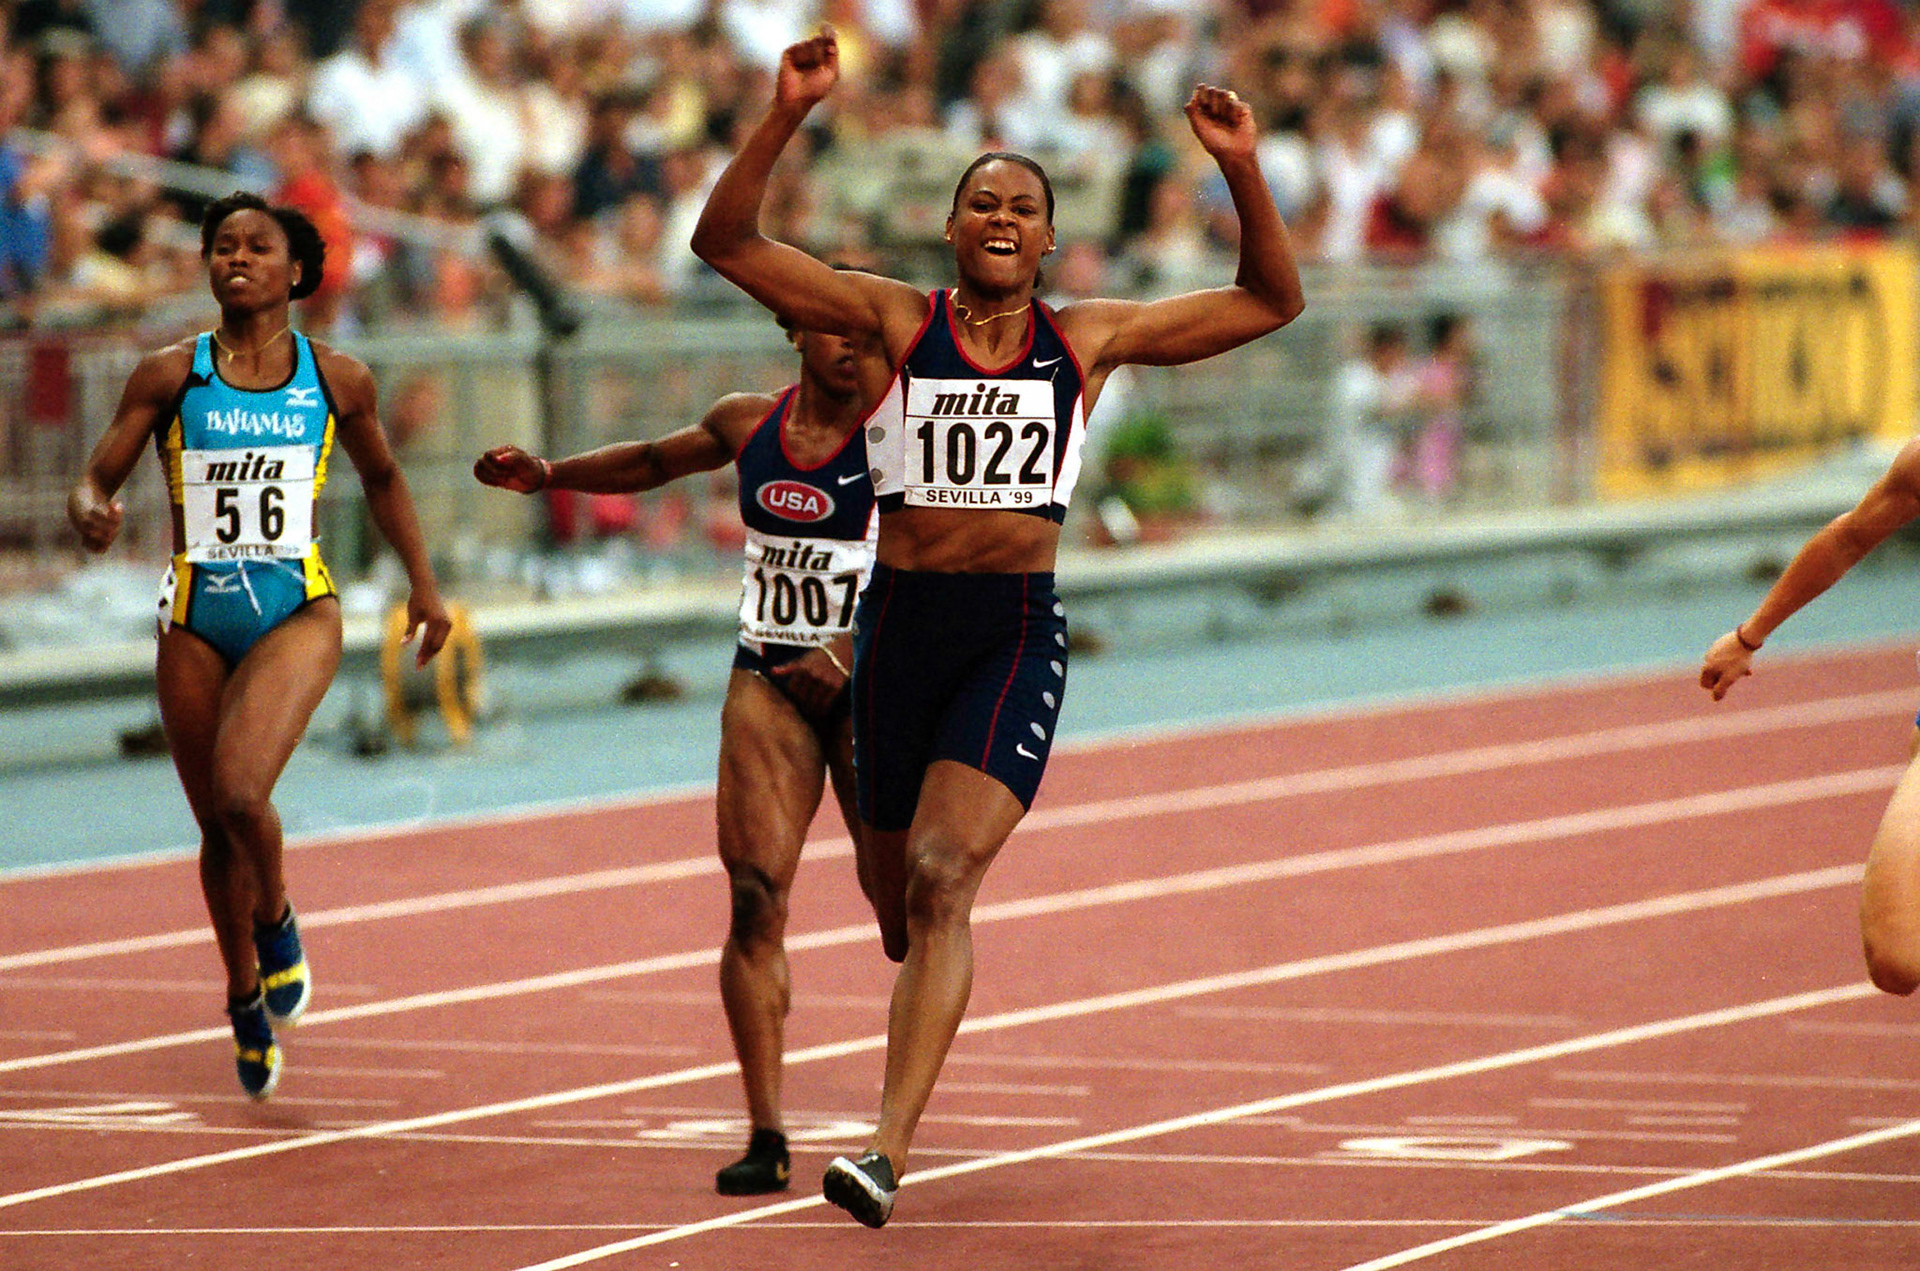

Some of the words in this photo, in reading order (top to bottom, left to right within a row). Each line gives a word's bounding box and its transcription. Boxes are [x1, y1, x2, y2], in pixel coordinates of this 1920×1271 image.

[931, 383, 1021, 416] mita
[206, 408, 306, 438] BAHAMAS
[205, 452, 285, 482] mita
[916, 421, 1050, 486] 1022
[769, 487, 820, 515] USA
[925, 489, 1002, 504] SEVILLA
[1008, 490, 1034, 504] '99
[215, 486, 285, 544] 56
[760, 541, 834, 571] mita
[754, 566, 859, 628] 1007
